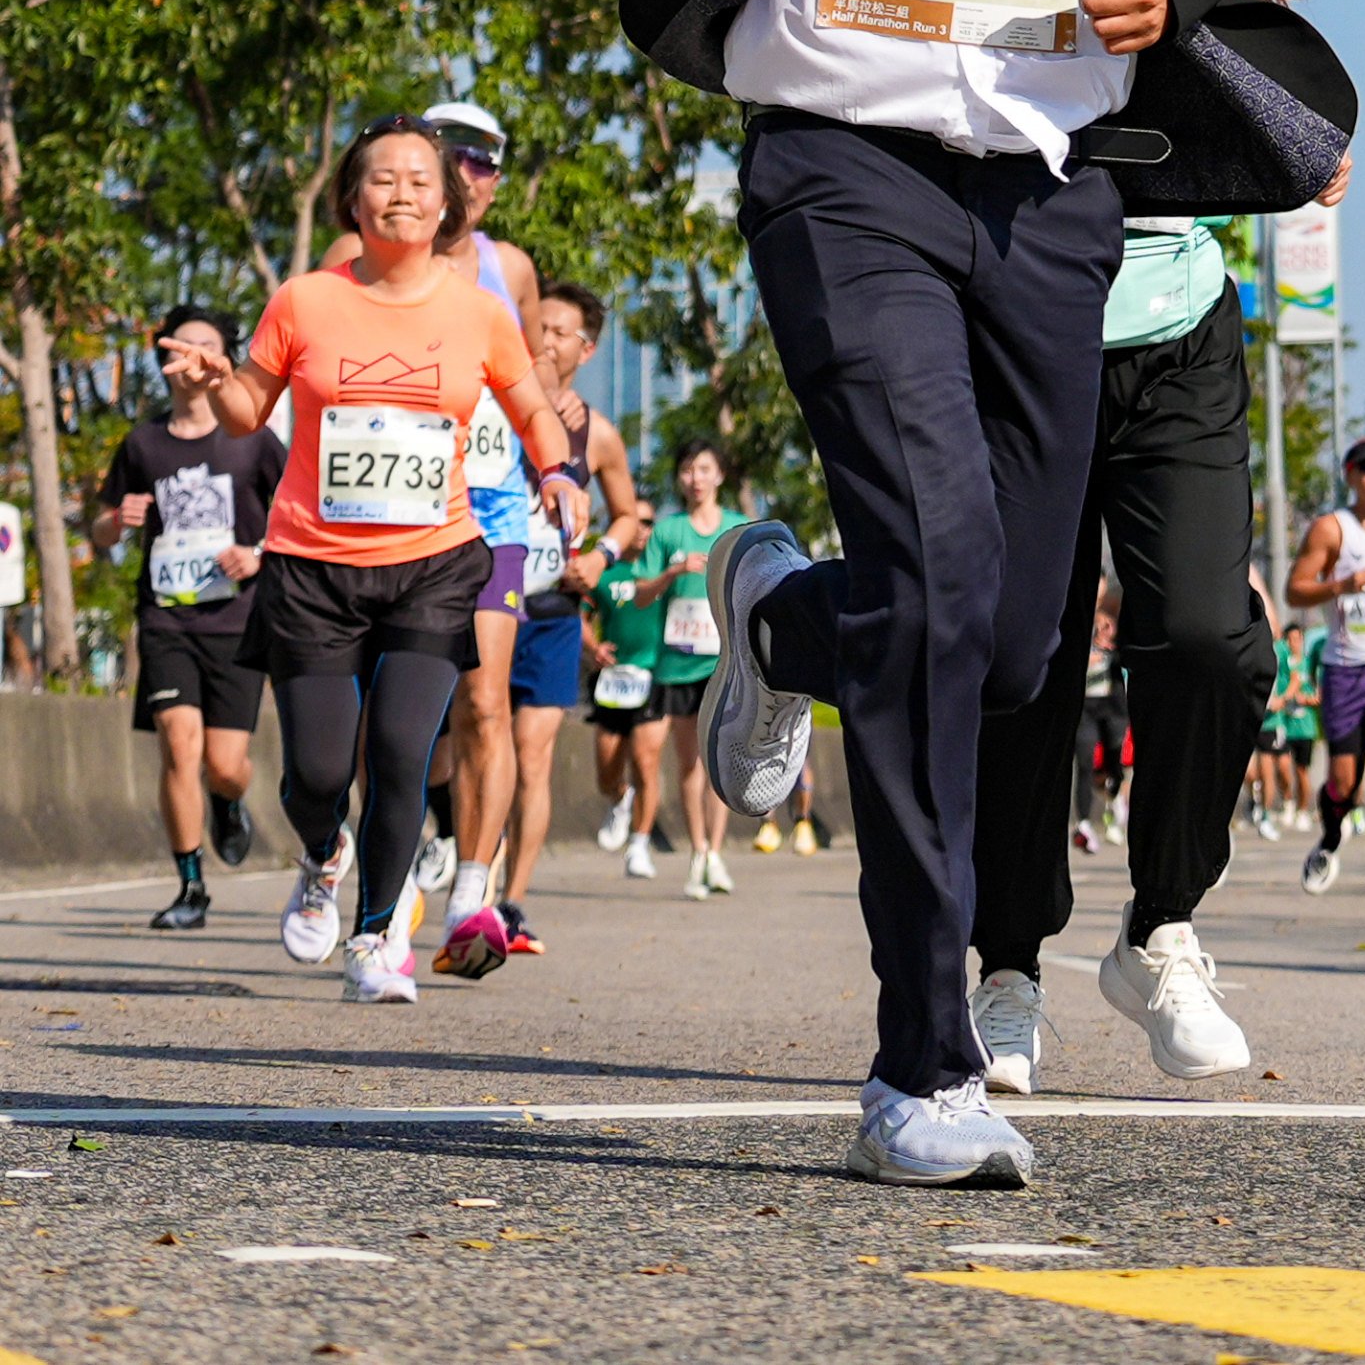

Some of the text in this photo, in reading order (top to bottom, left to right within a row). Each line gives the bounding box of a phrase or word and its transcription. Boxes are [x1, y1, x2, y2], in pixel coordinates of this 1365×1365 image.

[831, 9, 948, 35] Half Marathon Run 3
[328, 452, 445, 490] E2733
